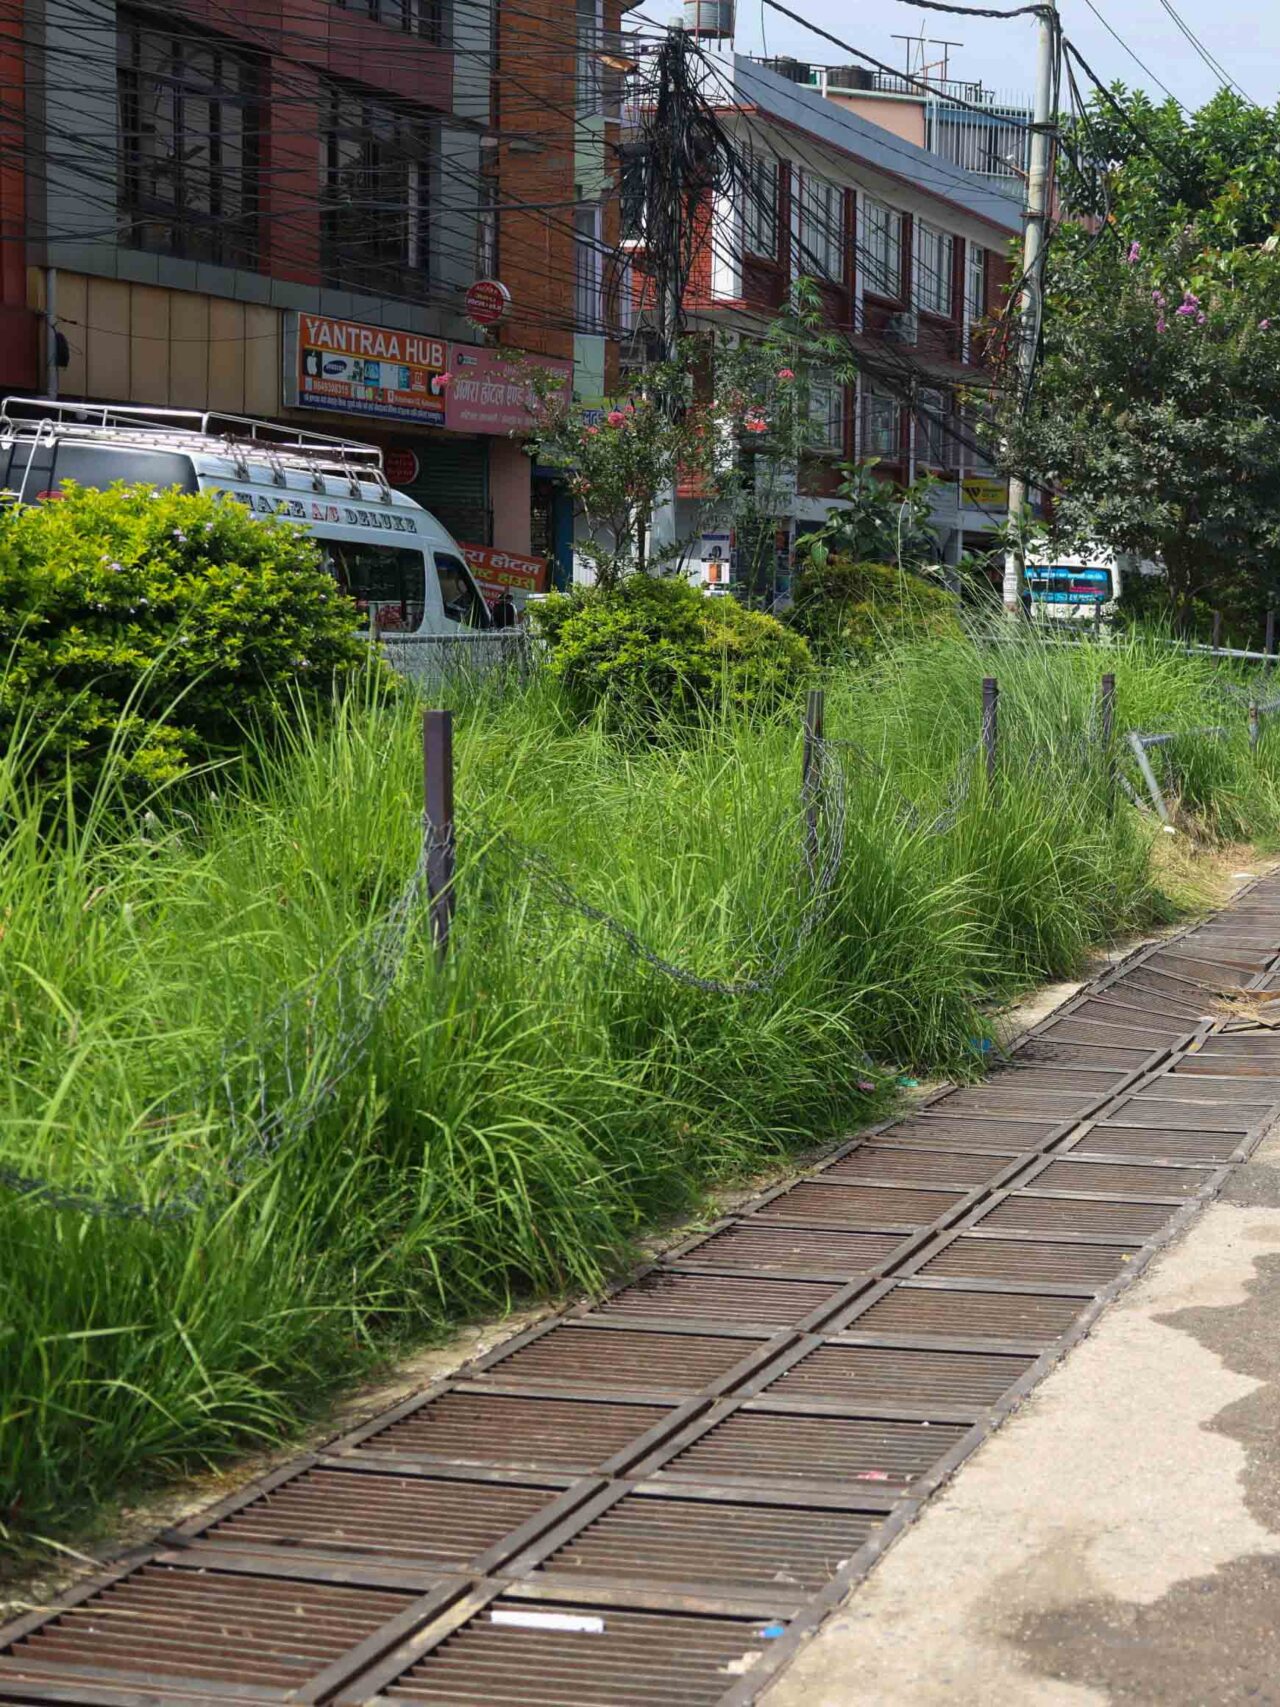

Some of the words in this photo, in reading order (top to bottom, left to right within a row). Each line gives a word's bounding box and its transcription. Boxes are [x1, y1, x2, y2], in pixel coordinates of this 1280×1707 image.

[306, 318, 401, 360] YANTRAA
[406, 338, 443, 367] HUB
[490, 553, 542, 575] होटल
